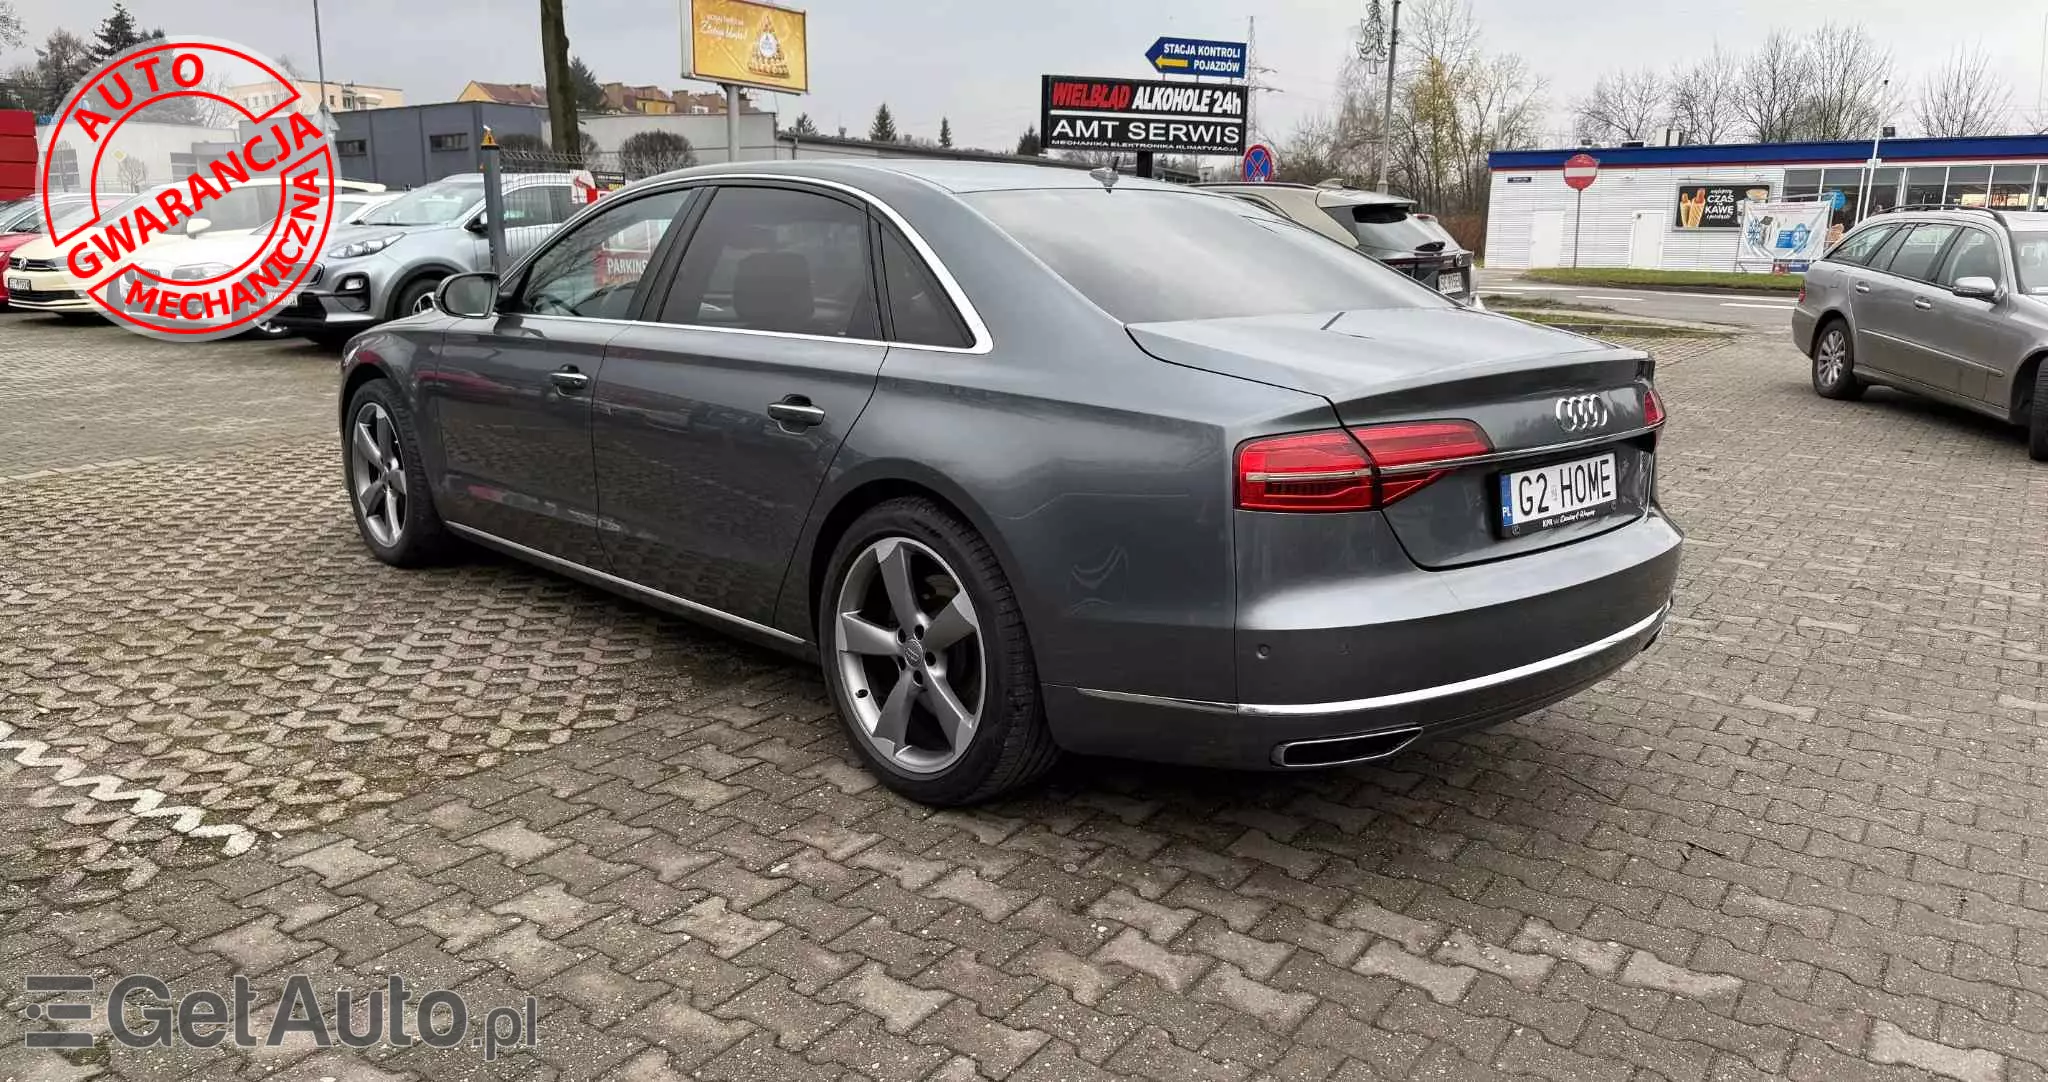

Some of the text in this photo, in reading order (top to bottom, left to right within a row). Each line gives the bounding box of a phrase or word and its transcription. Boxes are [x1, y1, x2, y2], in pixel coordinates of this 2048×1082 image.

[1163, 43, 1240, 58] STACJA KONTROLI
[1193, 59, 1240, 73] POJAZDÓW
[1052, 82, 1242, 115] WIELBŁĄD ALKOHOLE 24h
[1051, 119, 1240, 144] AMT SERWIS
[1051, 139, 1238, 153] MECHANIKA ELEKTRONIKA KLIMATYZACJA
[1707, 195, 1735, 203] CZAS
[1519, 458, 1612, 516] G2 HOME
[1502, 506, 1513, 517] PL
